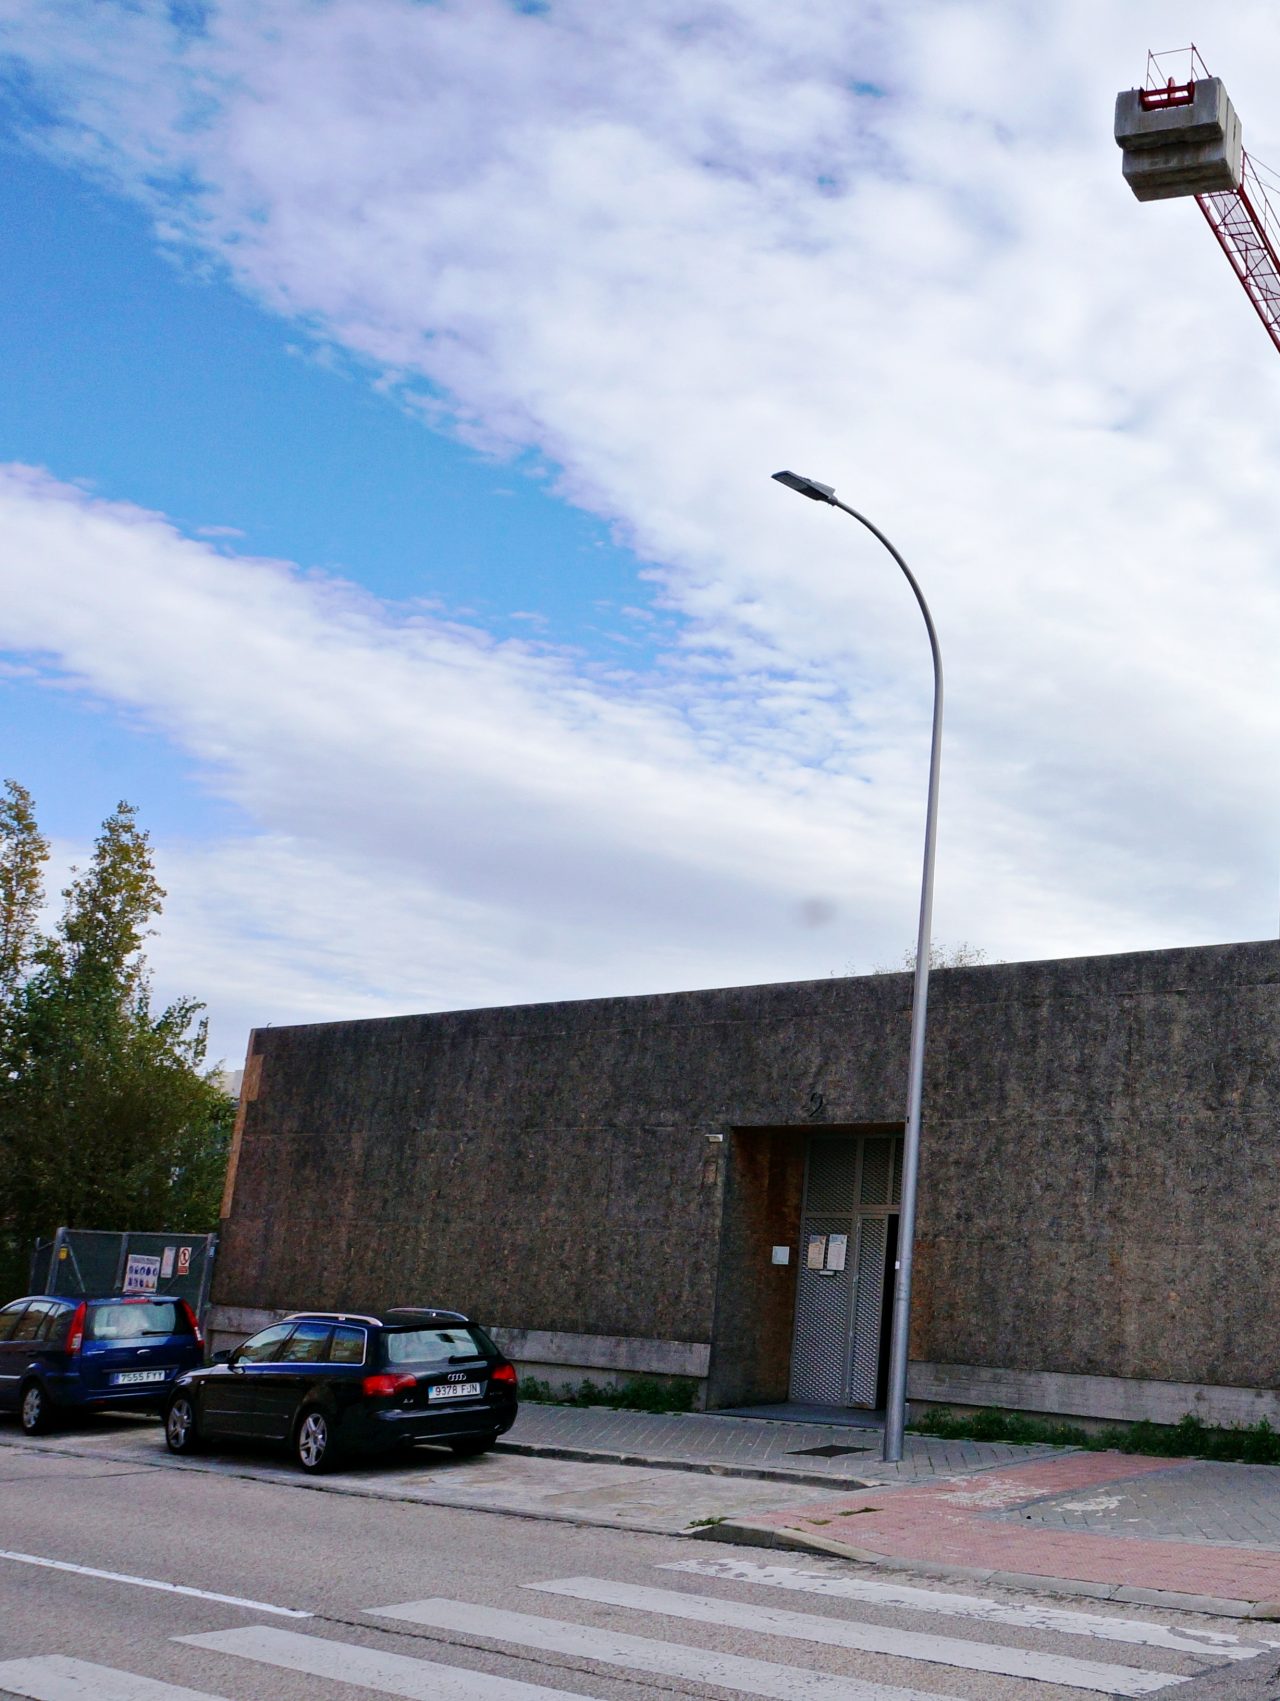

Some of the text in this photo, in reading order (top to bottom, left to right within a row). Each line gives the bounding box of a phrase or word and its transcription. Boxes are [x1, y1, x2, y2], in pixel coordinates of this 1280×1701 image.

[121, 1373, 144, 1382] 7555
[435, 1385, 458, 1396] 9378
[461, 1383, 478, 1394] FJN
